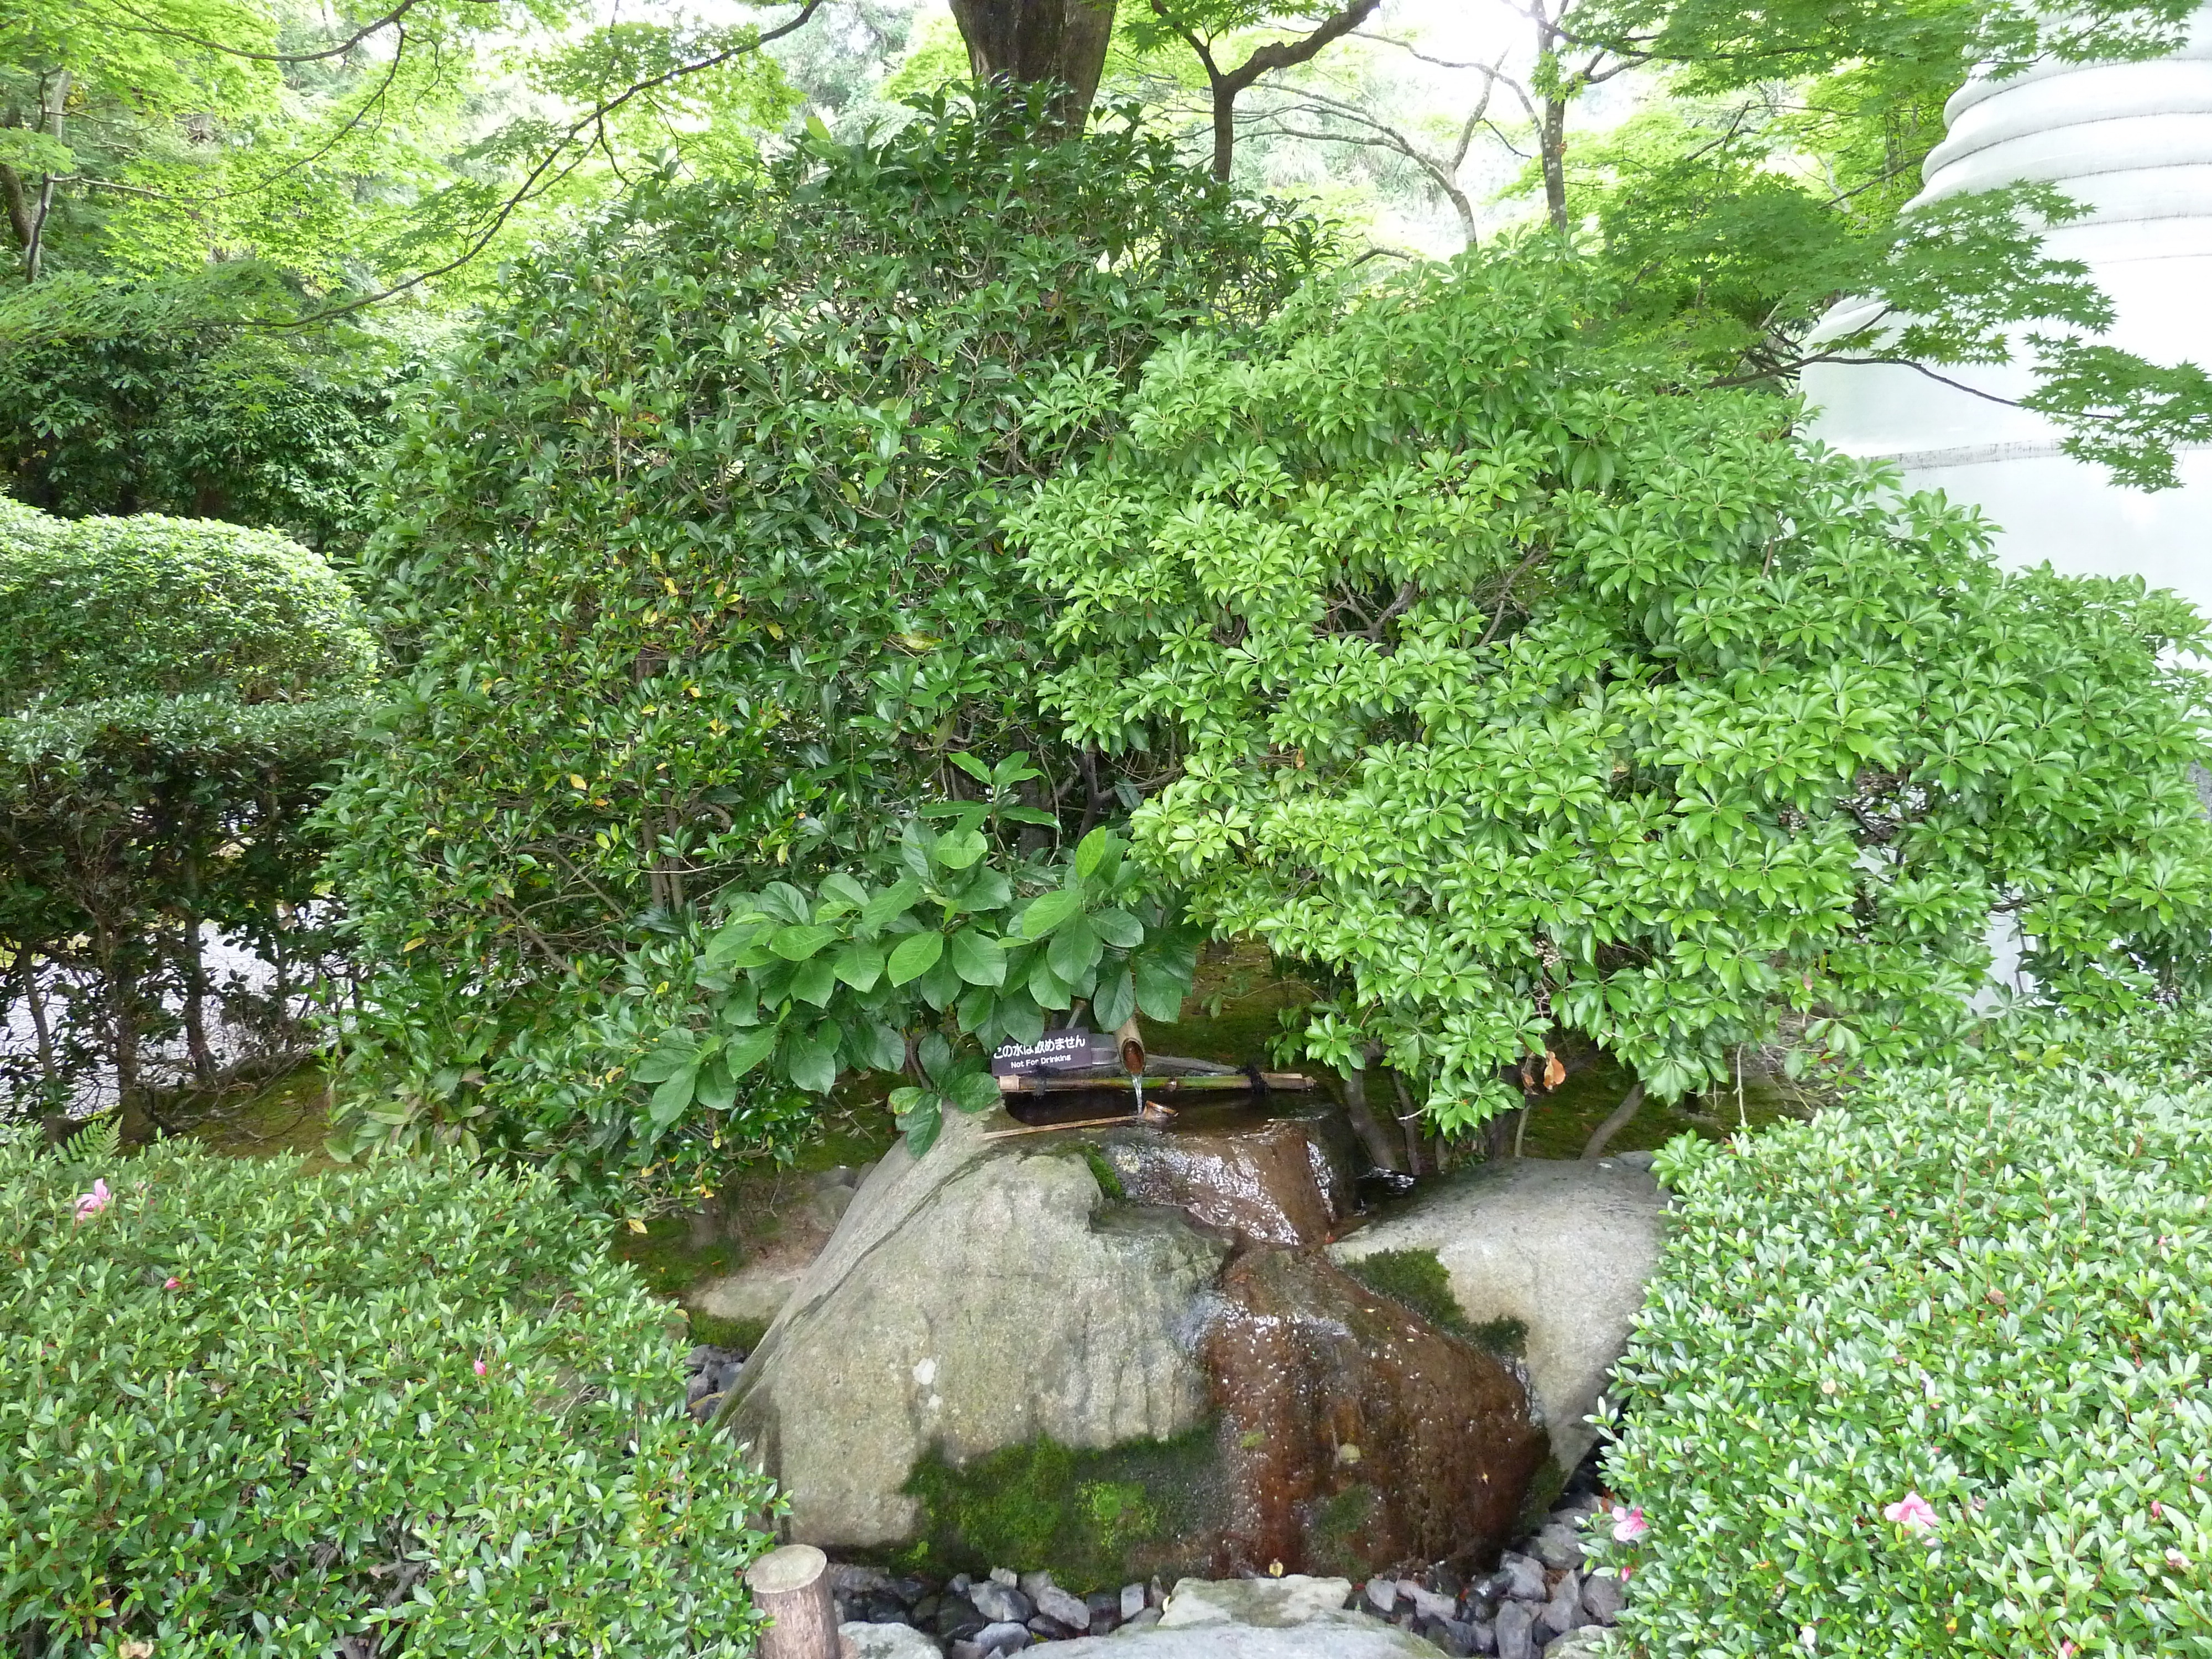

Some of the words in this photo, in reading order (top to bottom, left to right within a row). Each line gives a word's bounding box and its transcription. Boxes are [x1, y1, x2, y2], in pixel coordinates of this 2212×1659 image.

[994, 1035, 1086, 1059] この水は飲めません
[1041, 1055, 1071, 1064] Drinking
